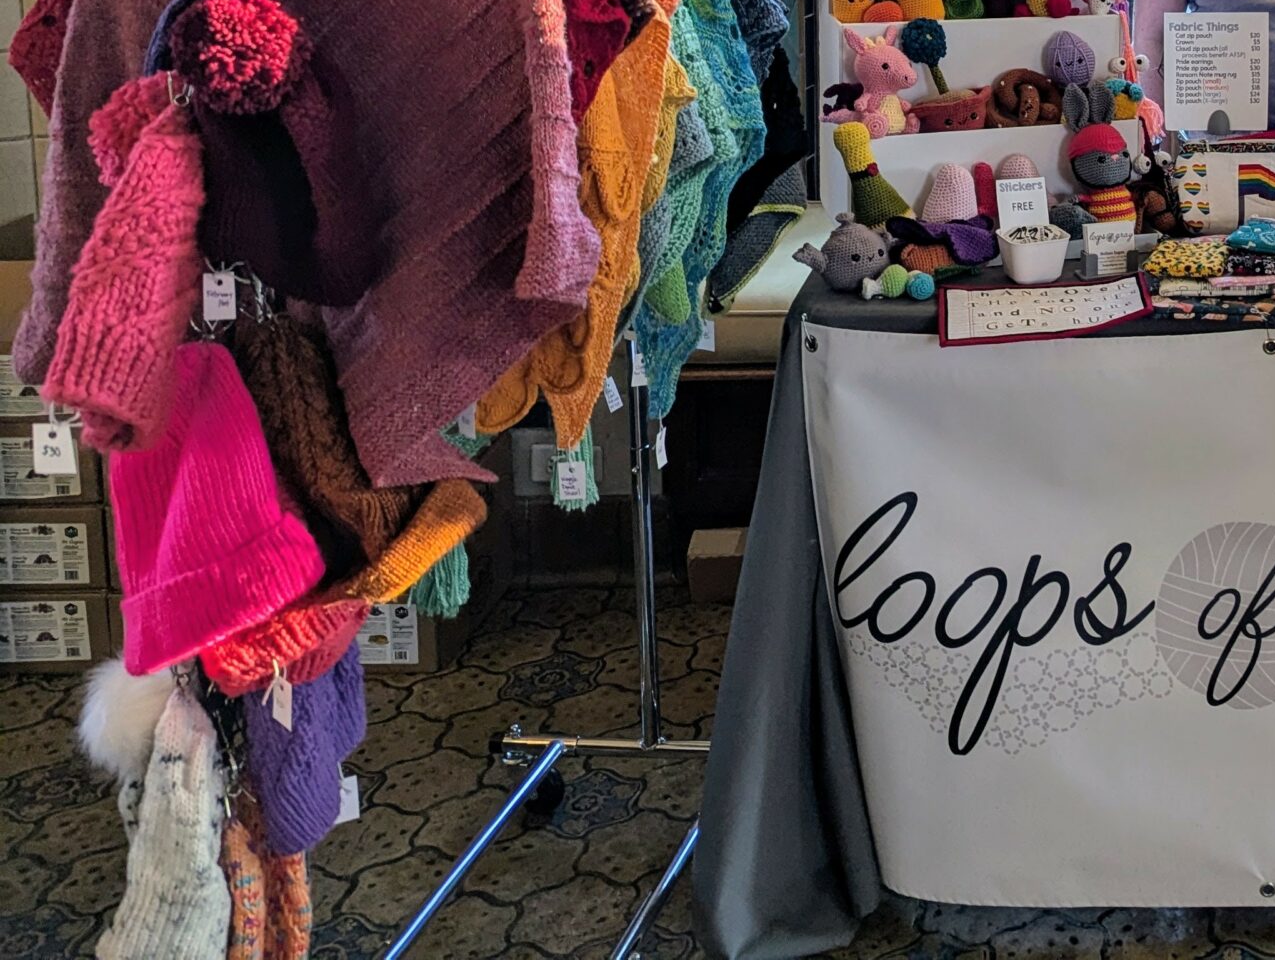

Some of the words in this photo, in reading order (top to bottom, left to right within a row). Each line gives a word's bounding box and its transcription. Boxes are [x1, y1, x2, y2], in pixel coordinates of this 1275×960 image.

[1169, 22, 1203, 32] Fabric
[1206, 22, 1239, 33] Things
[1000, 181, 1043, 193] Stickers
[1012, 201, 1034, 212] FREE
[1040, 305, 1076, 314] NO
[42, 444, 61, 457] $30
[834, 491, 1156, 756] loops
